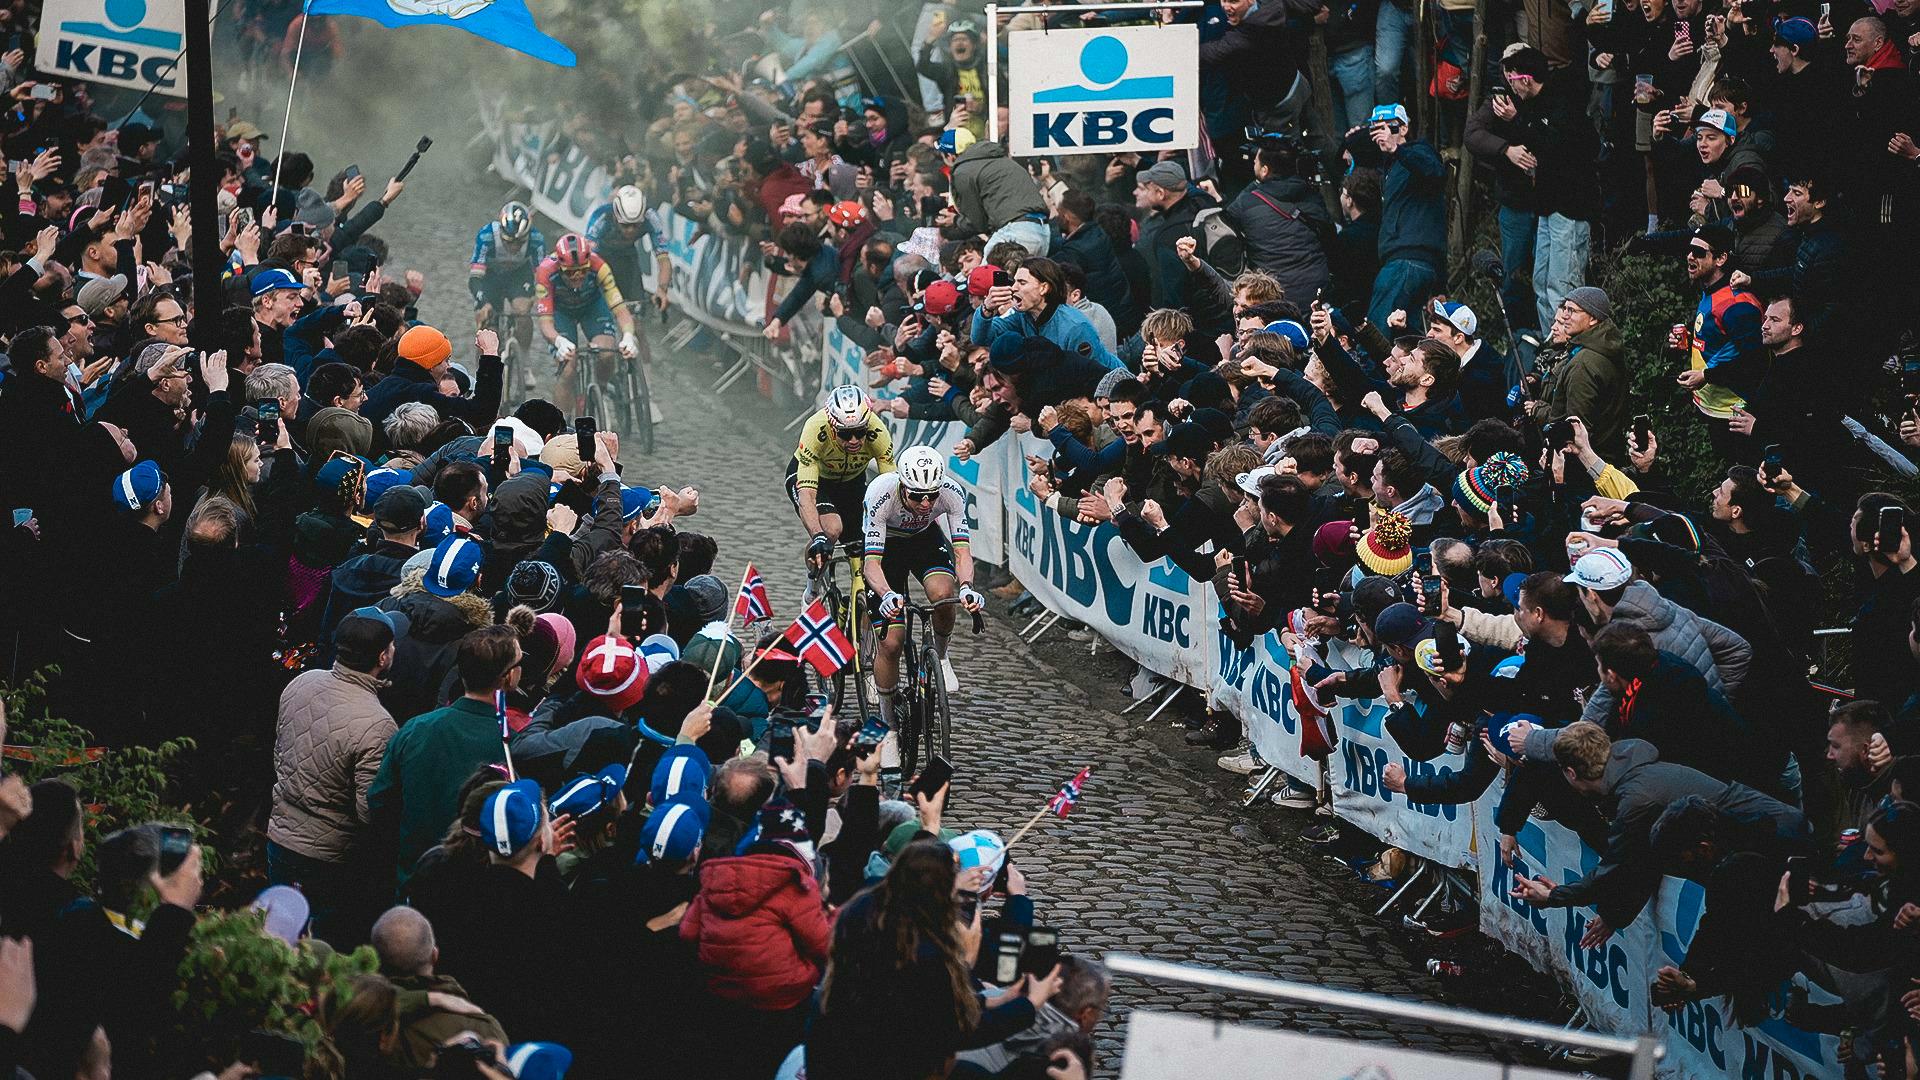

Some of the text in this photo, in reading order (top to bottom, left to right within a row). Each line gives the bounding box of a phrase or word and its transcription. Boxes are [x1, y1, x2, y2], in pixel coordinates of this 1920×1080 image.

[55, 39, 179, 89] KBC
[1032, 107, 1174, 149] KBC
[1015, 511, 1035, 566] KBC
[1040, 500, 1137, 626] KBC
[1143, 592, 1191, 649] KBC
[1251, 661, 1297, 735] KBC
[1341, 737, 1393, 803] KBC
[1565, 905, 1629, 1010] KBC
